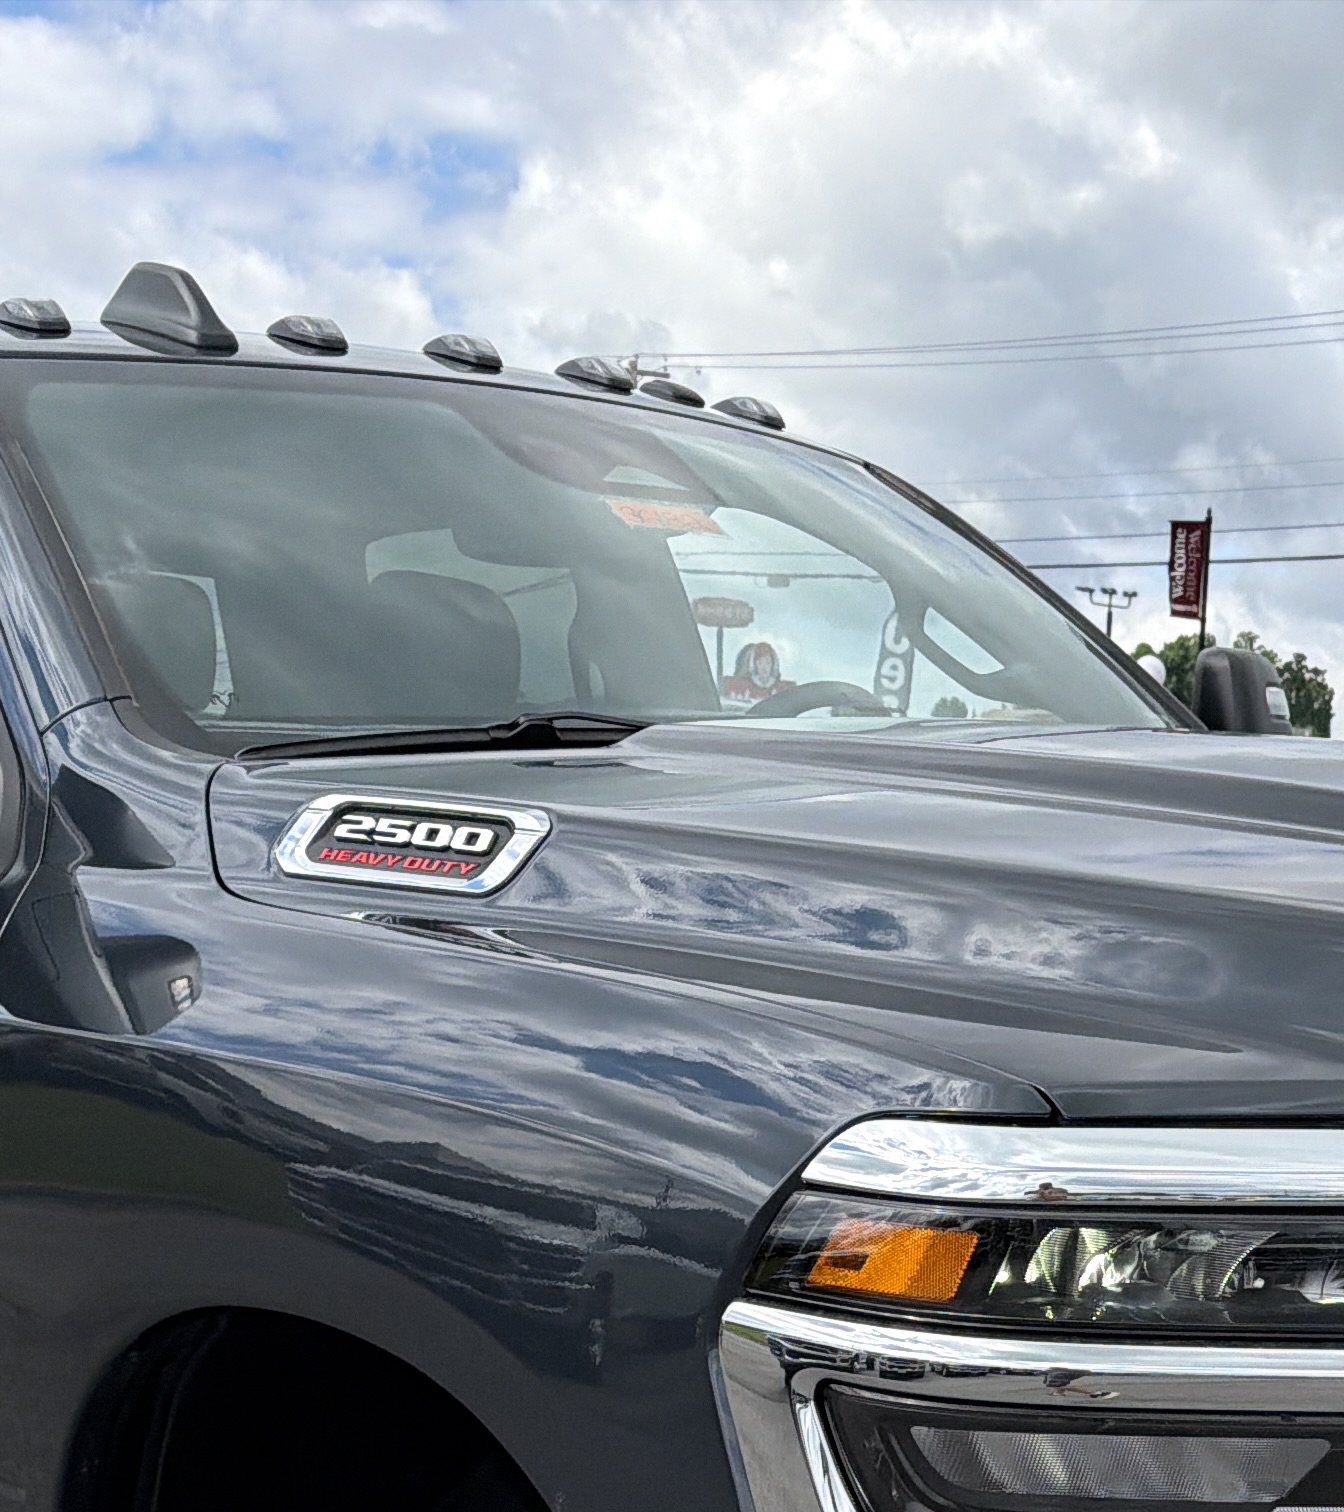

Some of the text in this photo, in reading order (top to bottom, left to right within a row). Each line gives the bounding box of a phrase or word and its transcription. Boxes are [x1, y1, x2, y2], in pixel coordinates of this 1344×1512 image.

[1171, 528, 1187, 599] Welcome
[333, 813, 494, 853] 2500
[320, 848, 478, 875] HEAVY DUTY
